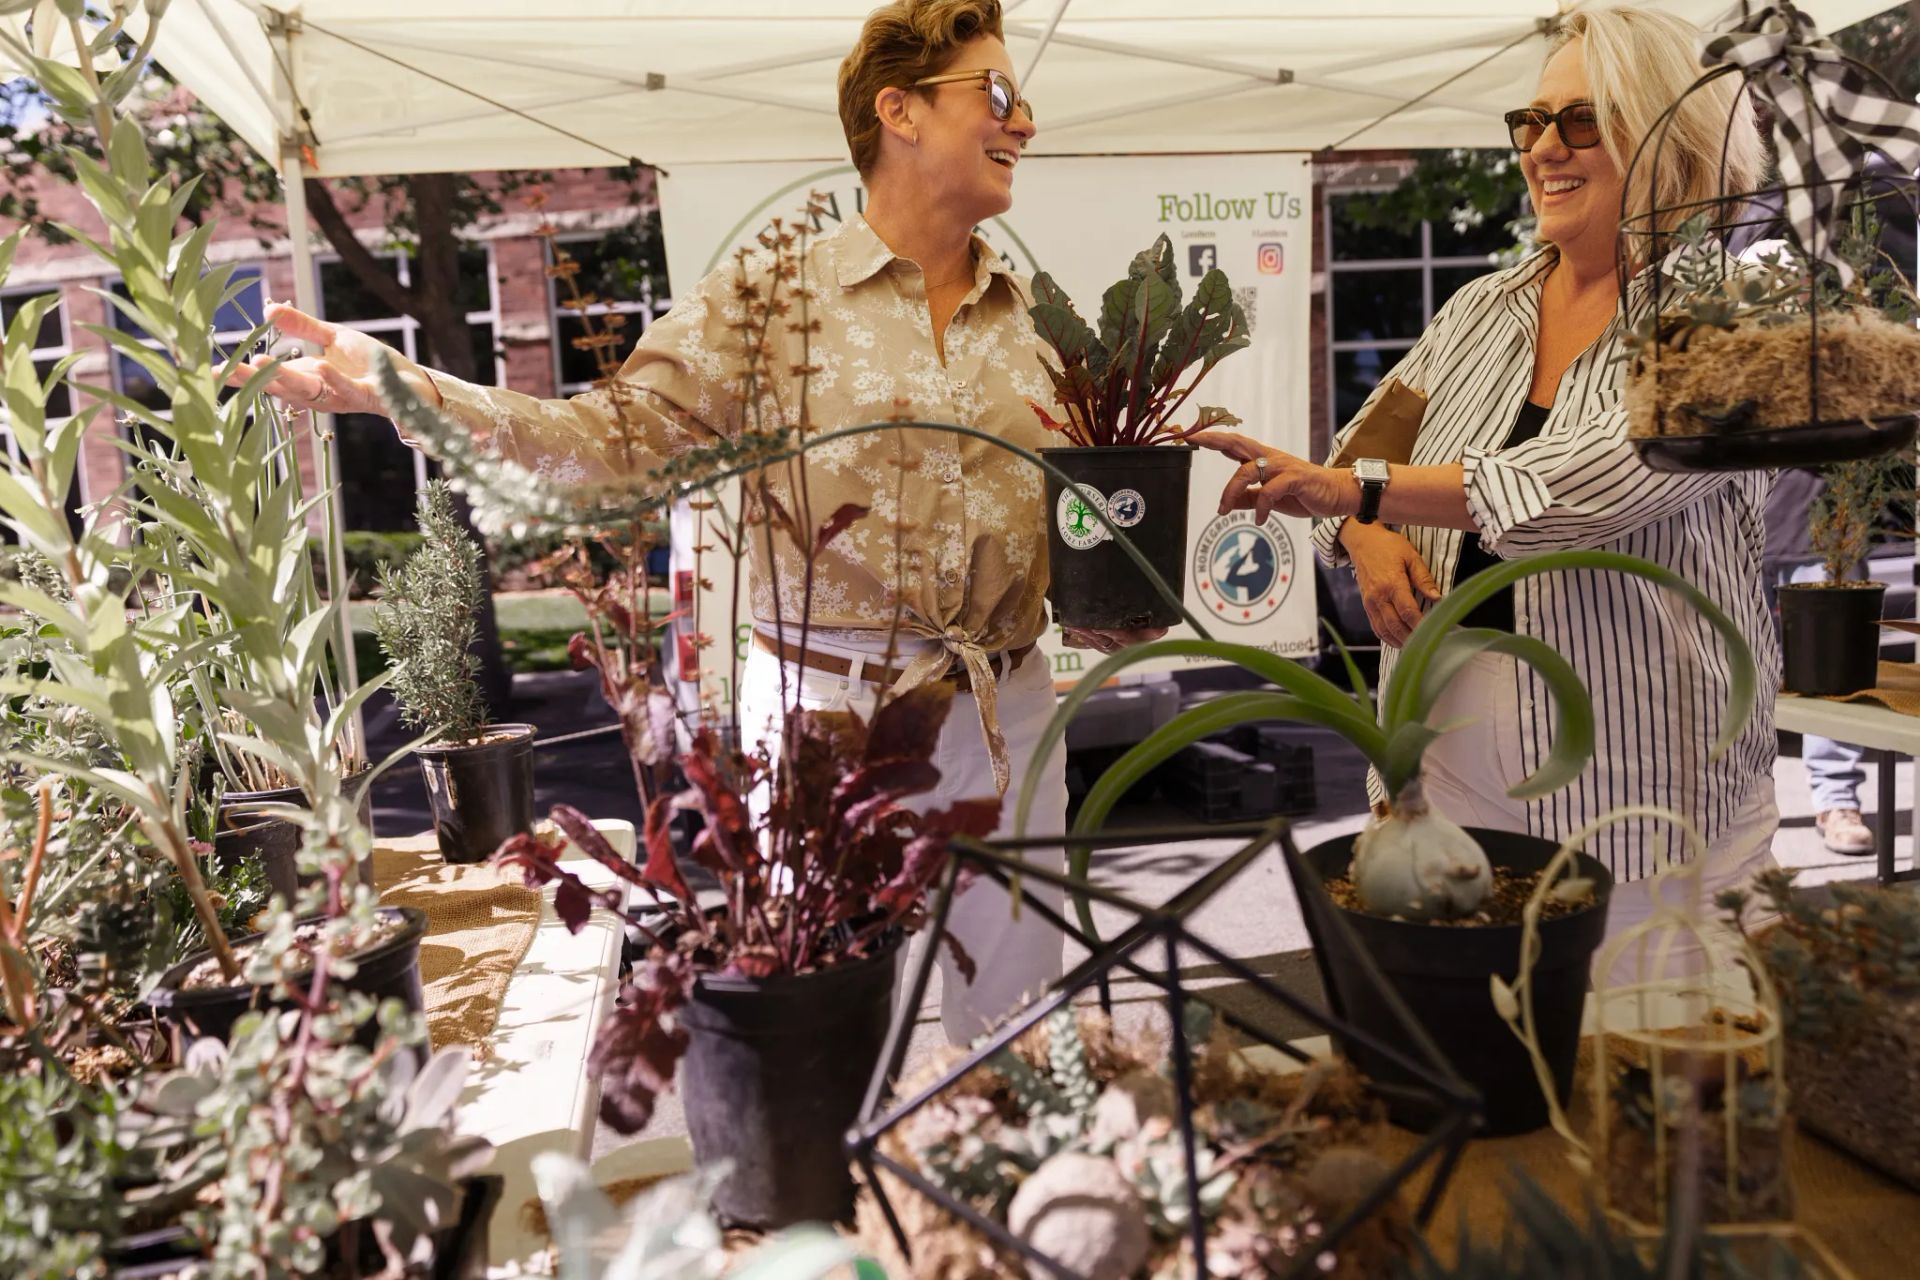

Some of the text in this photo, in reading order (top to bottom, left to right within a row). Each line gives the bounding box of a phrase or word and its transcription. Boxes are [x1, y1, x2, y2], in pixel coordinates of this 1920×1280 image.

[1157, 192, 1301, 222] Follow Us
[1079, 488, 1106, 513] URSERY
[1197, 512, 1291, 573] HOMEGROWN HEROES
[1248, 637, 1314, 653] oduced
